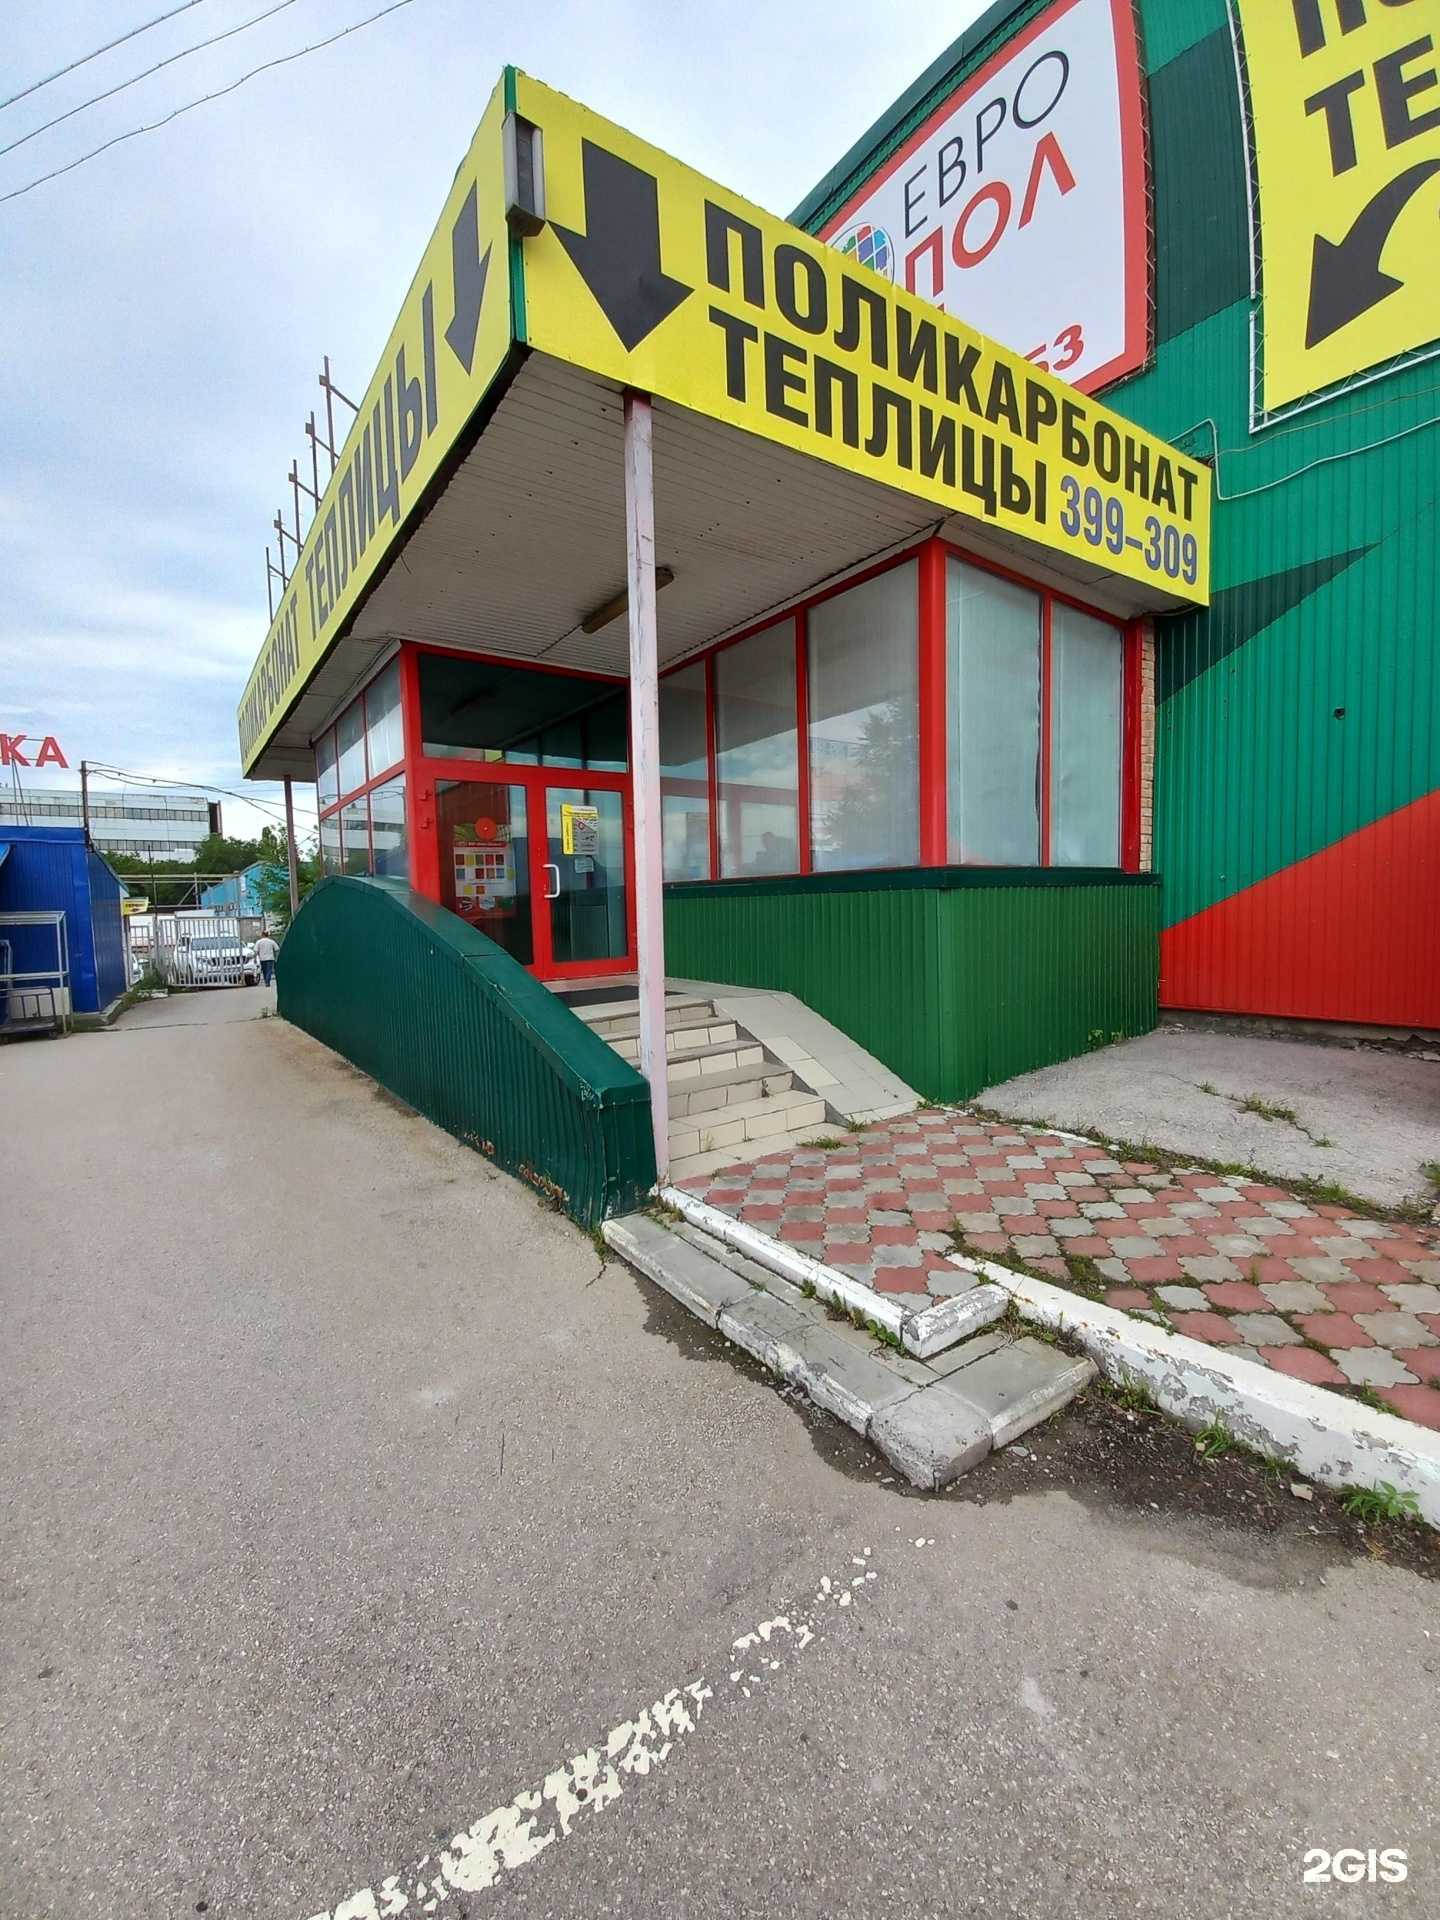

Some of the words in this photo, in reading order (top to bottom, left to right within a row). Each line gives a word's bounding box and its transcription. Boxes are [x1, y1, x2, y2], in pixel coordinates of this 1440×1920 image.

[905, 50, 1069, 239] ЕВРО
[1304, 34, 1440, 177] ТЕ
[905, 131, 1076, 297] ПОЛ
[704, 198, 1198, 521] ПОЛИКАРБОНАТ
[708, 305, 1047, 525] ТЕПЛИЦЫ
[1060, 475, 1197, 585] 399-309
[305, 279, 438, 641] ТЕПЛИЦЫ
[0, 733, 69, 768] КА
